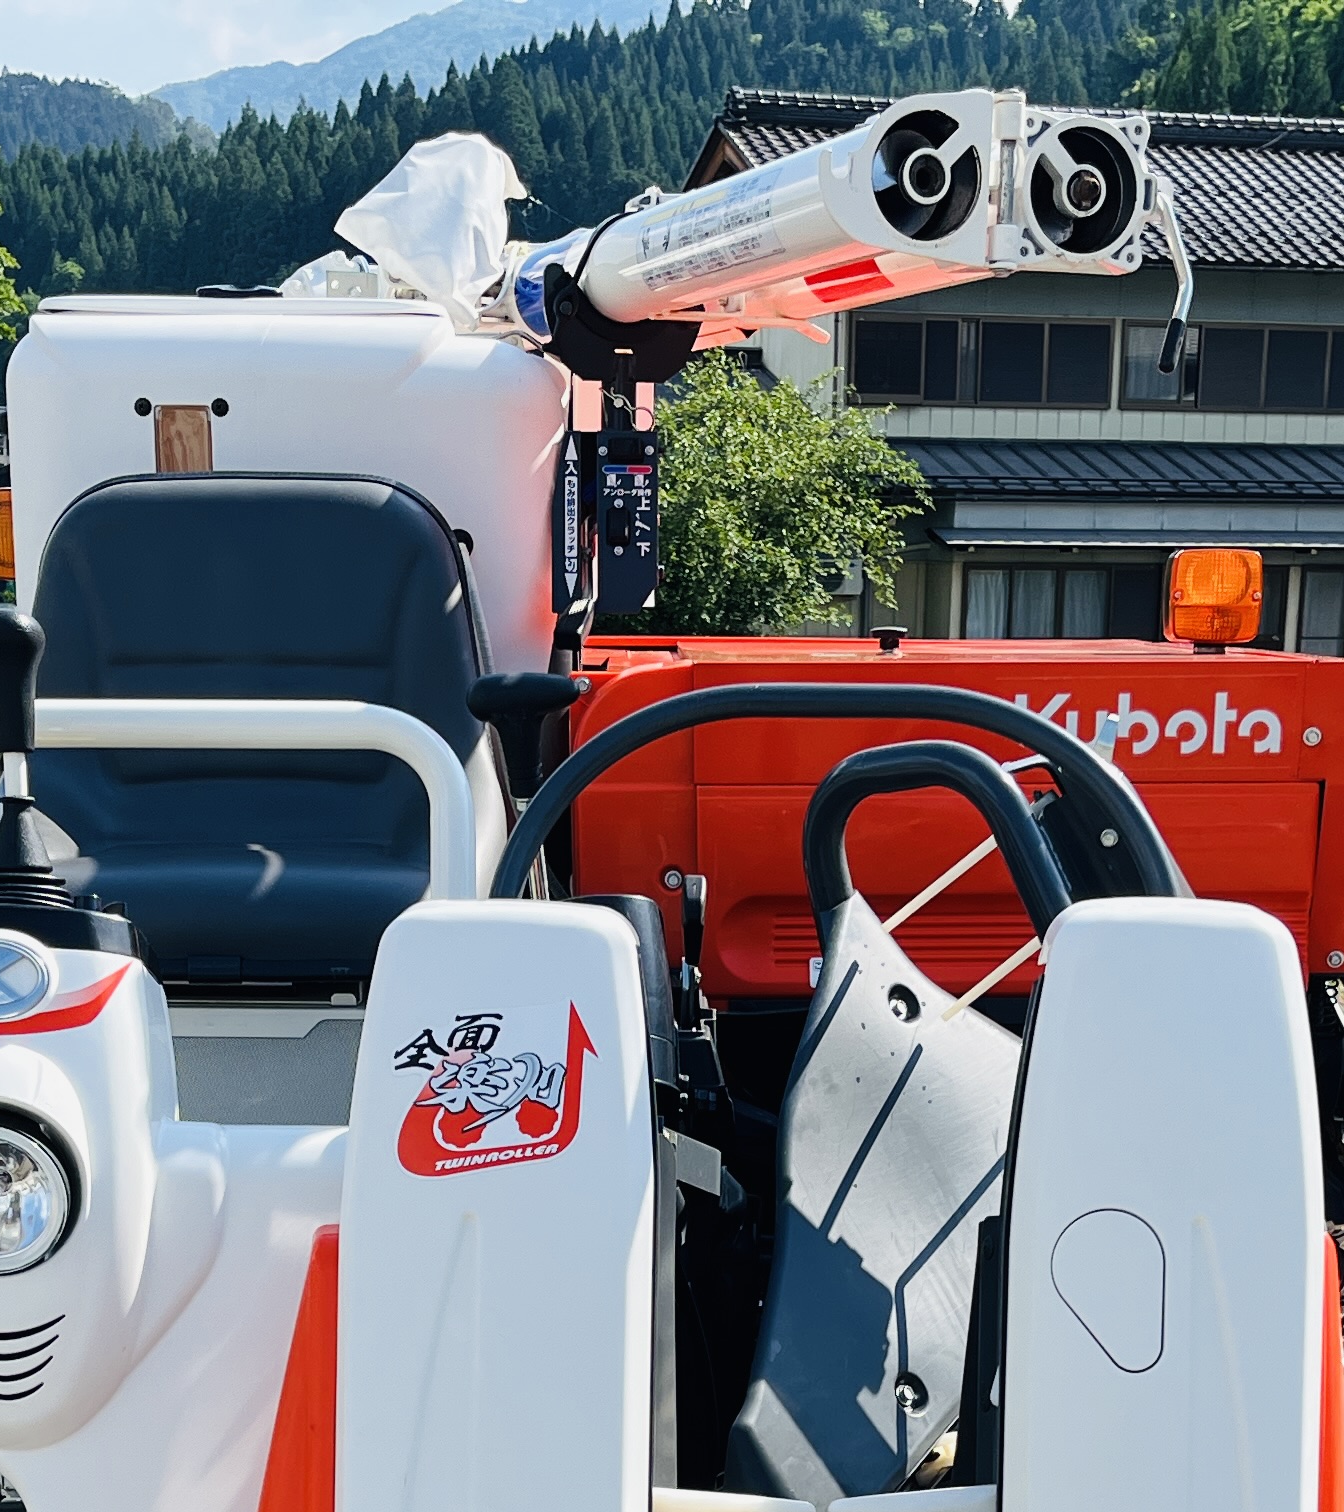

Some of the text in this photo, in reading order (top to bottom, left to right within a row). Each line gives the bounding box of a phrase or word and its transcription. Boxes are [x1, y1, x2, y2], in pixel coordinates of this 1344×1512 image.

[564, 461, 578, 475] 入
[636, 497, 651, 511] 上
[636, 542, 651, 557] 下
[394, 1013, 503, 1070] 全面
[435, 1143, 559, 1171] TWINROLLER
